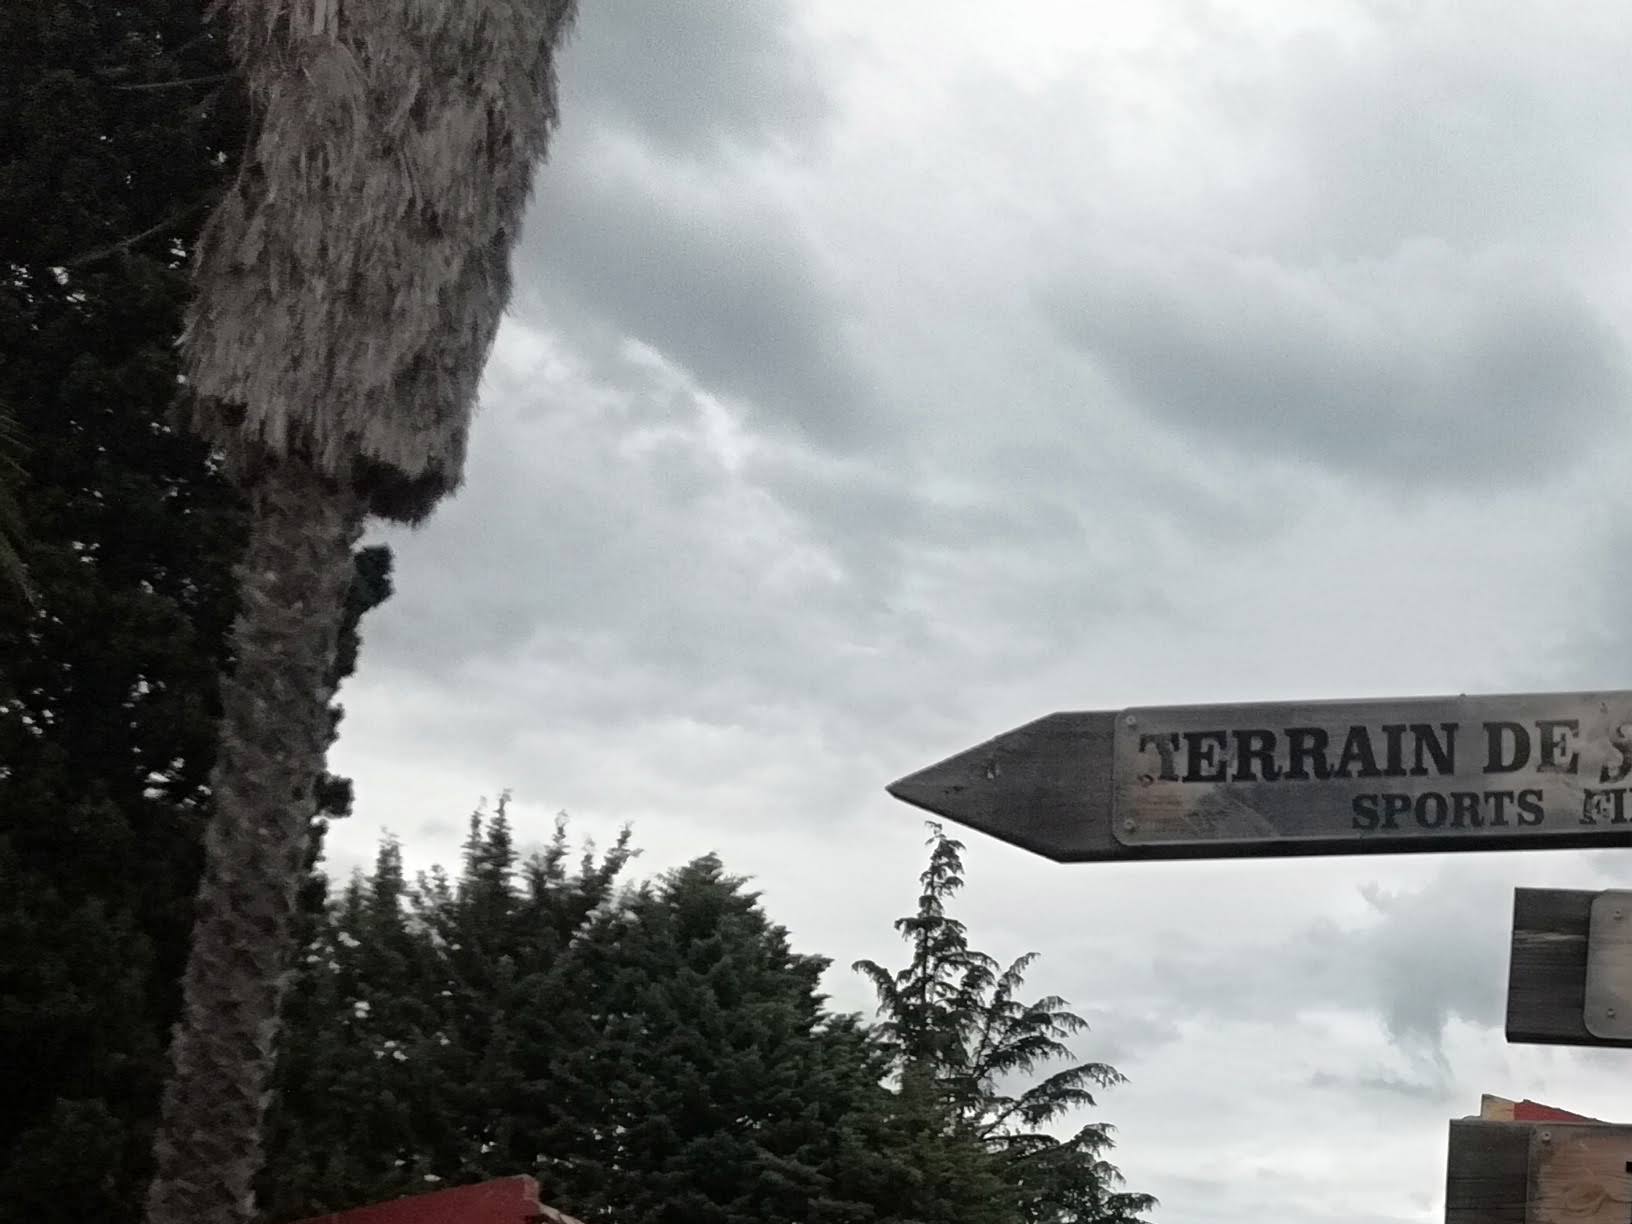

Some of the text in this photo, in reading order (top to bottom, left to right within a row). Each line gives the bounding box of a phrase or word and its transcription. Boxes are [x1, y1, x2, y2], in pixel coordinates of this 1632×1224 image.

[1138, 722, 1460, 784] TERRAIN
[1482, 718, 1580, 776] DE
[1351, 788, 1545, 830] SPORTS
